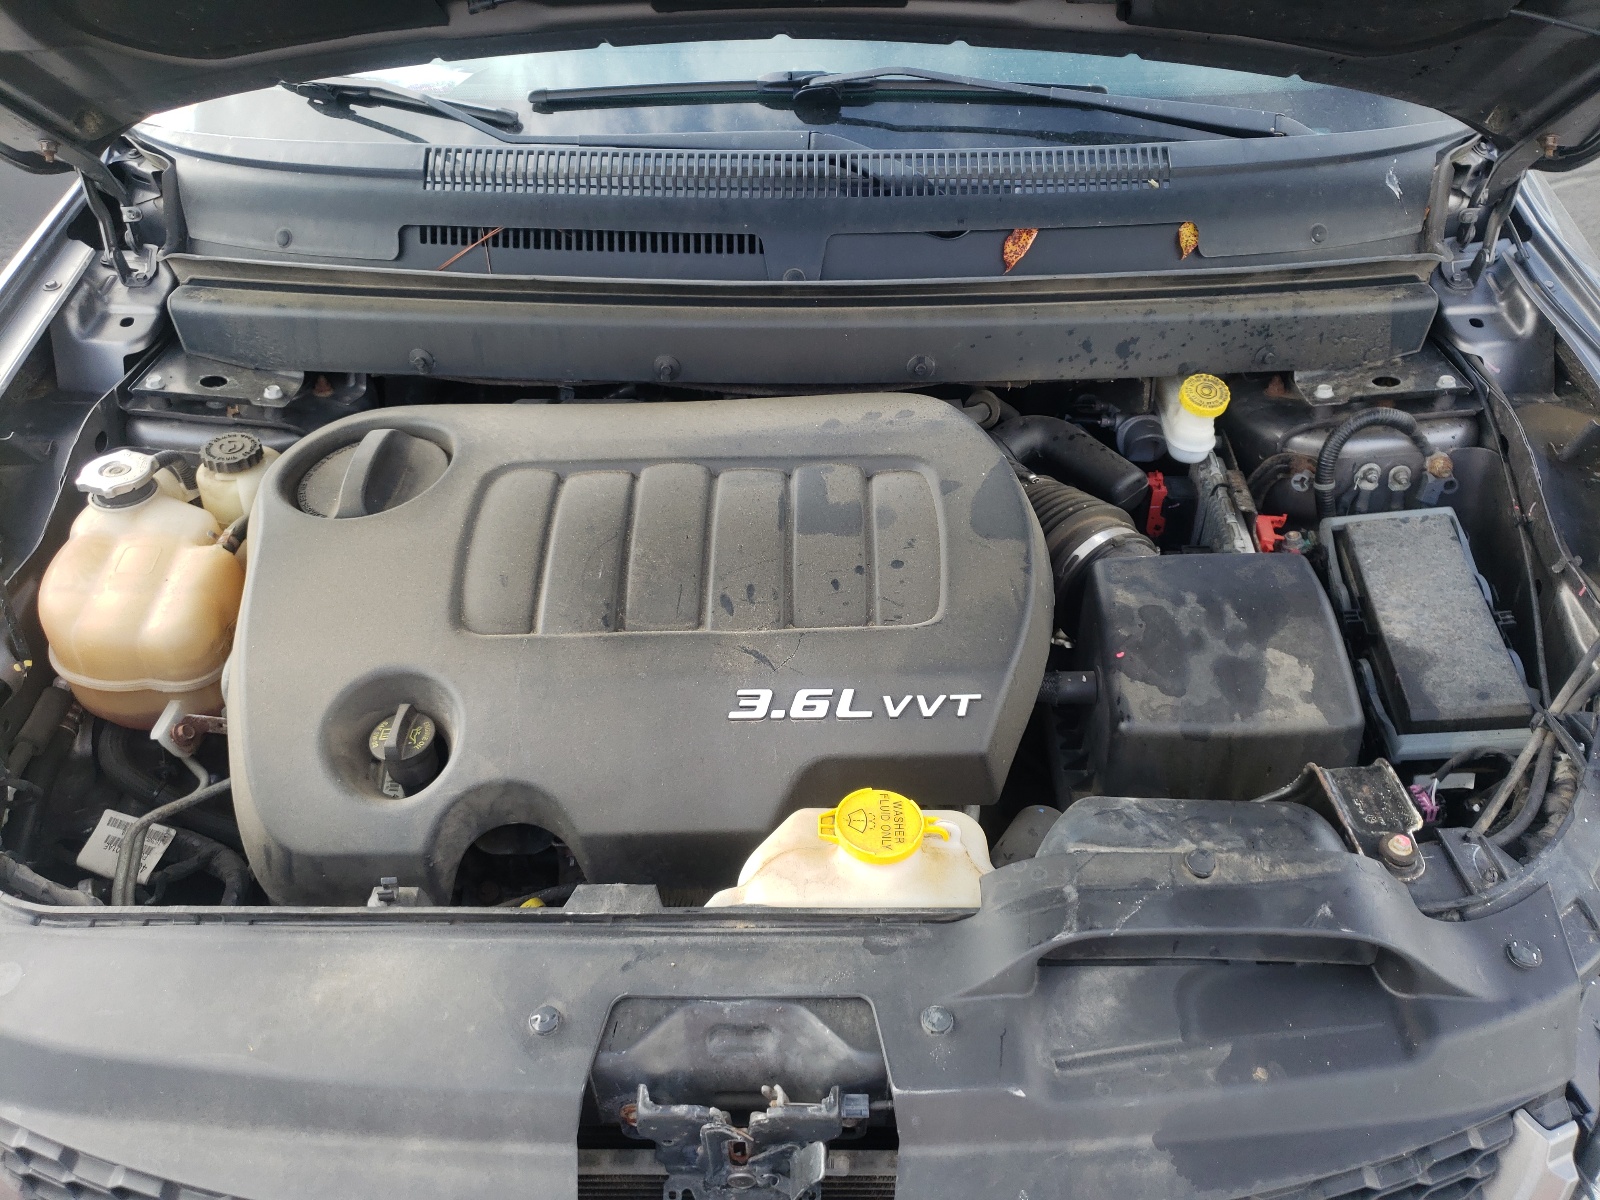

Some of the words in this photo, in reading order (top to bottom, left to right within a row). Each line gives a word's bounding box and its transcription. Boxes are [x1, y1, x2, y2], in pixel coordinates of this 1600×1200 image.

[728, 688, 874, 721] 3.6L
[882, 693, 982, 720] VVT
[413, 741, 424, 750] OIL
[879, 793, 891, 821] FLUID
[893, 801, 905, 844] WASHER
[880, 824, 893, 851] ONLY
